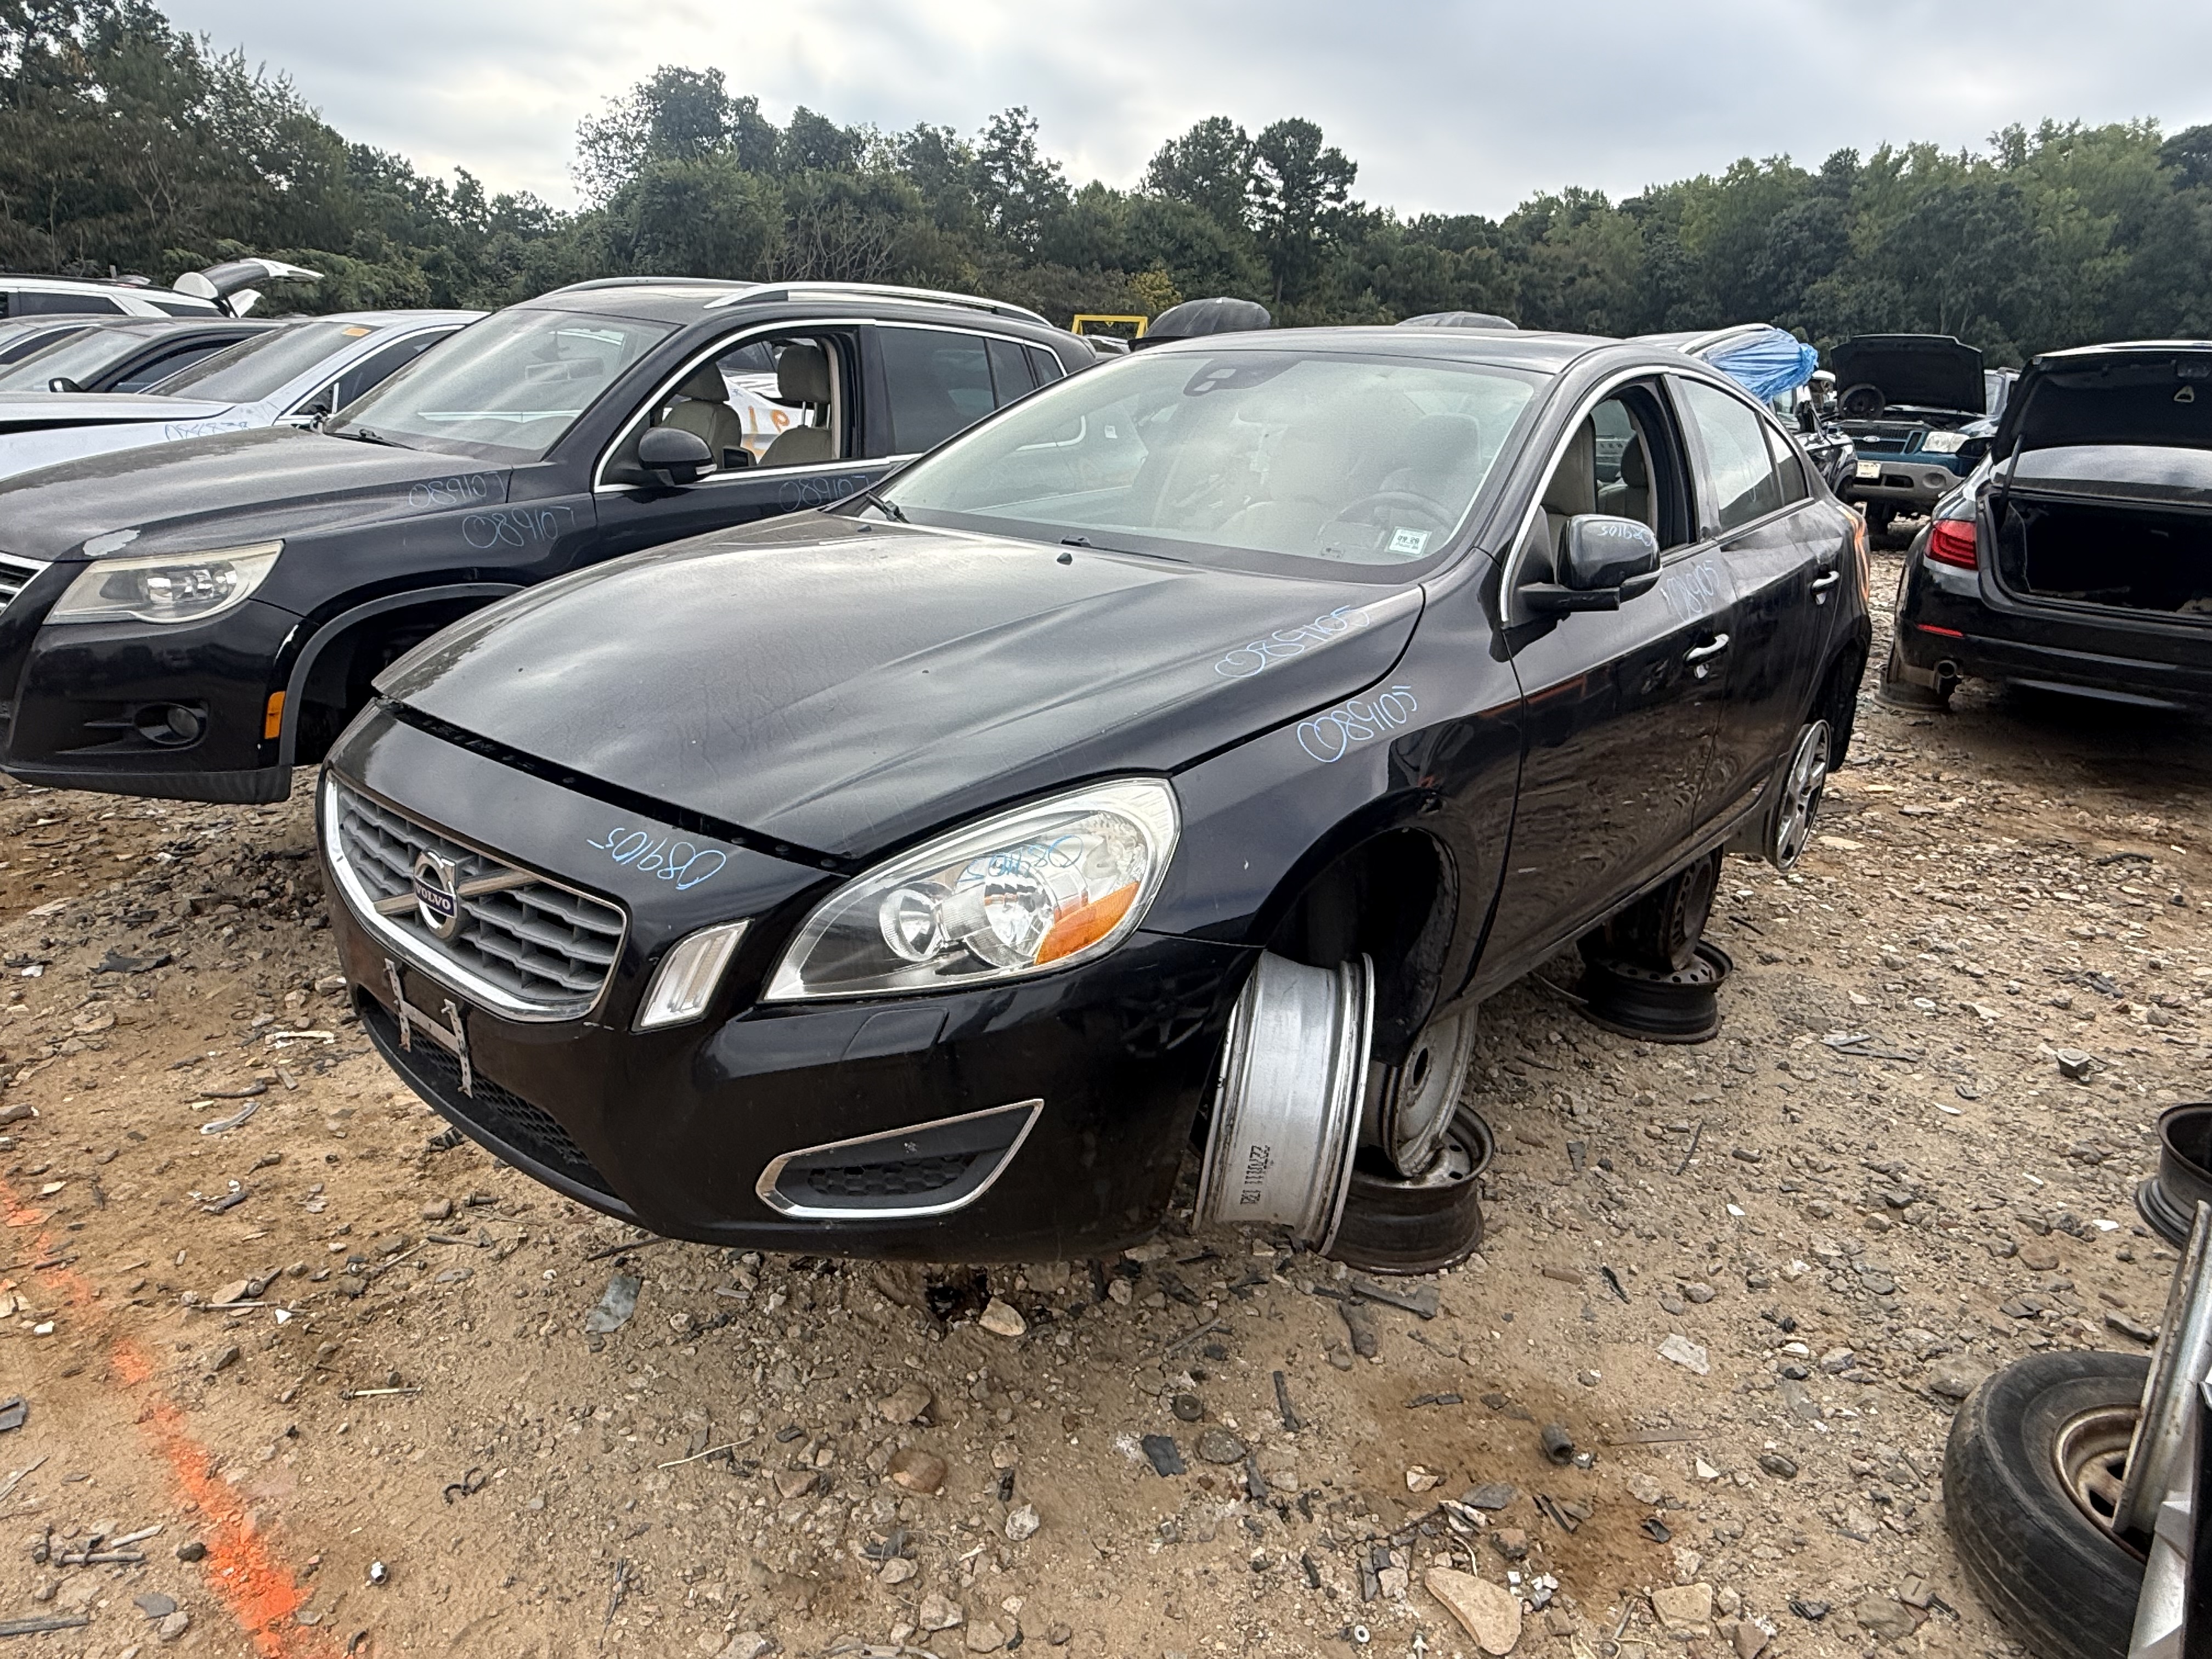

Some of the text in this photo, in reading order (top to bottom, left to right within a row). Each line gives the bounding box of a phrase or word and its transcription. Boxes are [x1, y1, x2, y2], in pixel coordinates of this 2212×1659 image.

[409, 471, 506, 509] 089107
[462, 506, 575, 549] 089107
[1215, 604, 1370, 678] 089105
[1296, 685, 1413, 763] 089105
[586, 827, 727, 890] 089105
[415, 882, 452, 910] VOLVO
